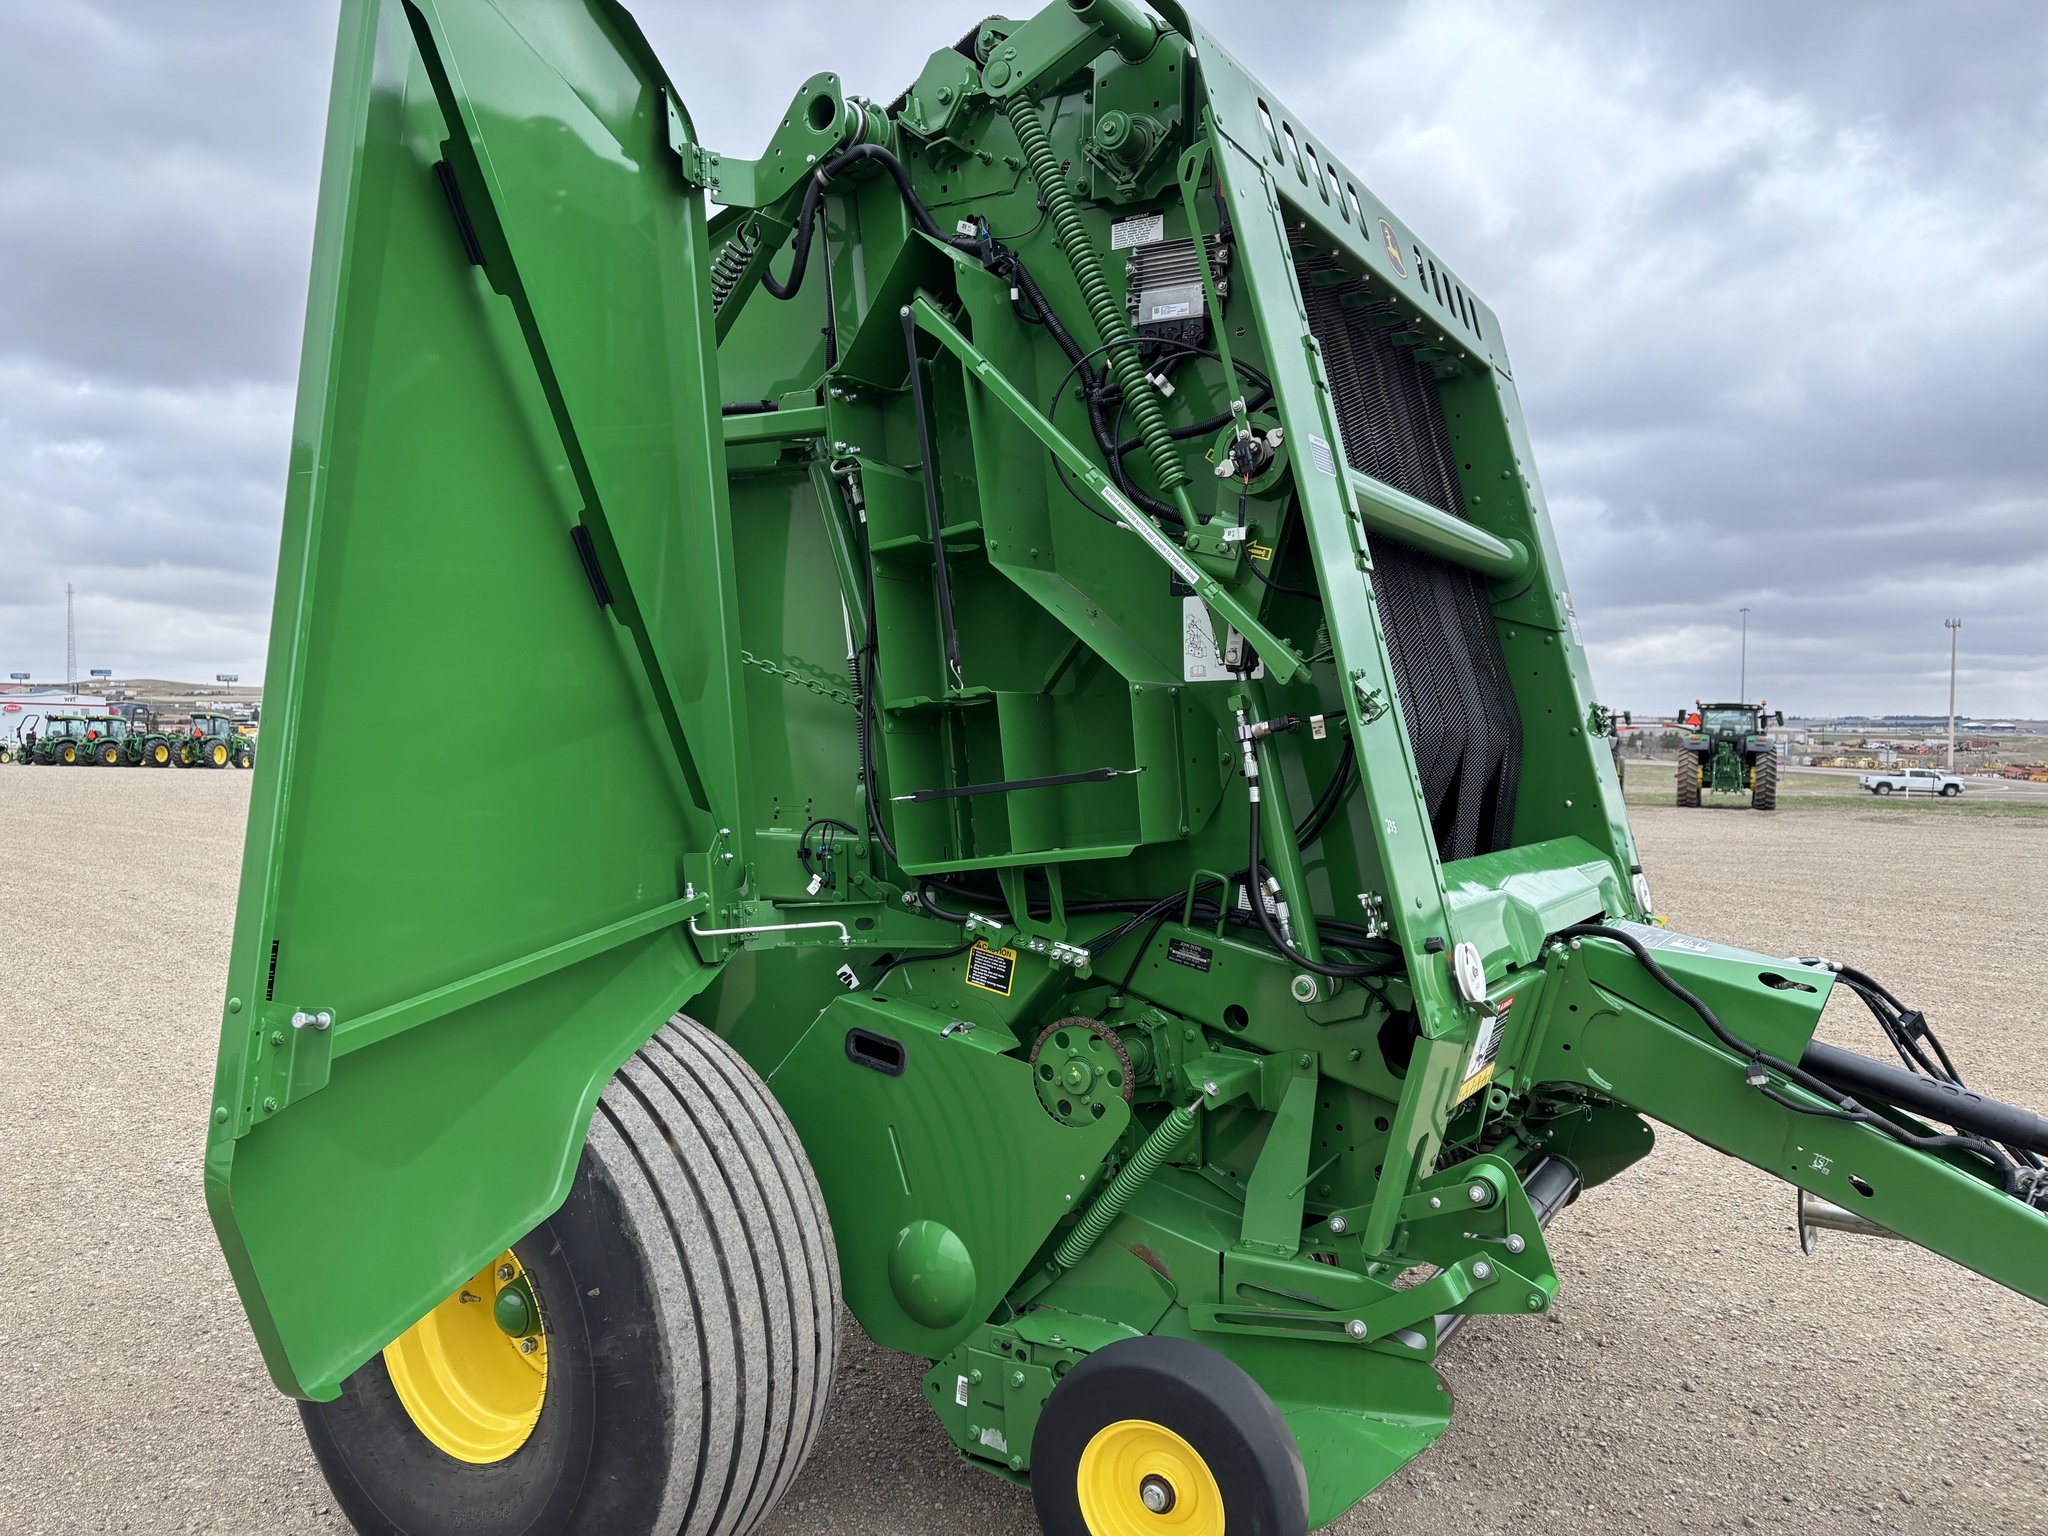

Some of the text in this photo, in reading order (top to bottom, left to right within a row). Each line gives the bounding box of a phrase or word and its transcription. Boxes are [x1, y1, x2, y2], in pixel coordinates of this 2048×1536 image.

[1125, 212, 1150, 221] IMPORTANT
[1104, 488, 1120, 504] REMOVE
[1117, 502, 1127, 512] ARM
[1125, 509, 1137, 522] FROM
[1134, 519, 1148, 533] NOTCH
[1146, 530, 1156, 540] AND
[1153, 538, 1168, 552] LOWER
[1170, 555, 1186, 571] THREAD
[1183, 568, 1197, 582] TWINE
[982, 944, 1012, 957] CION
